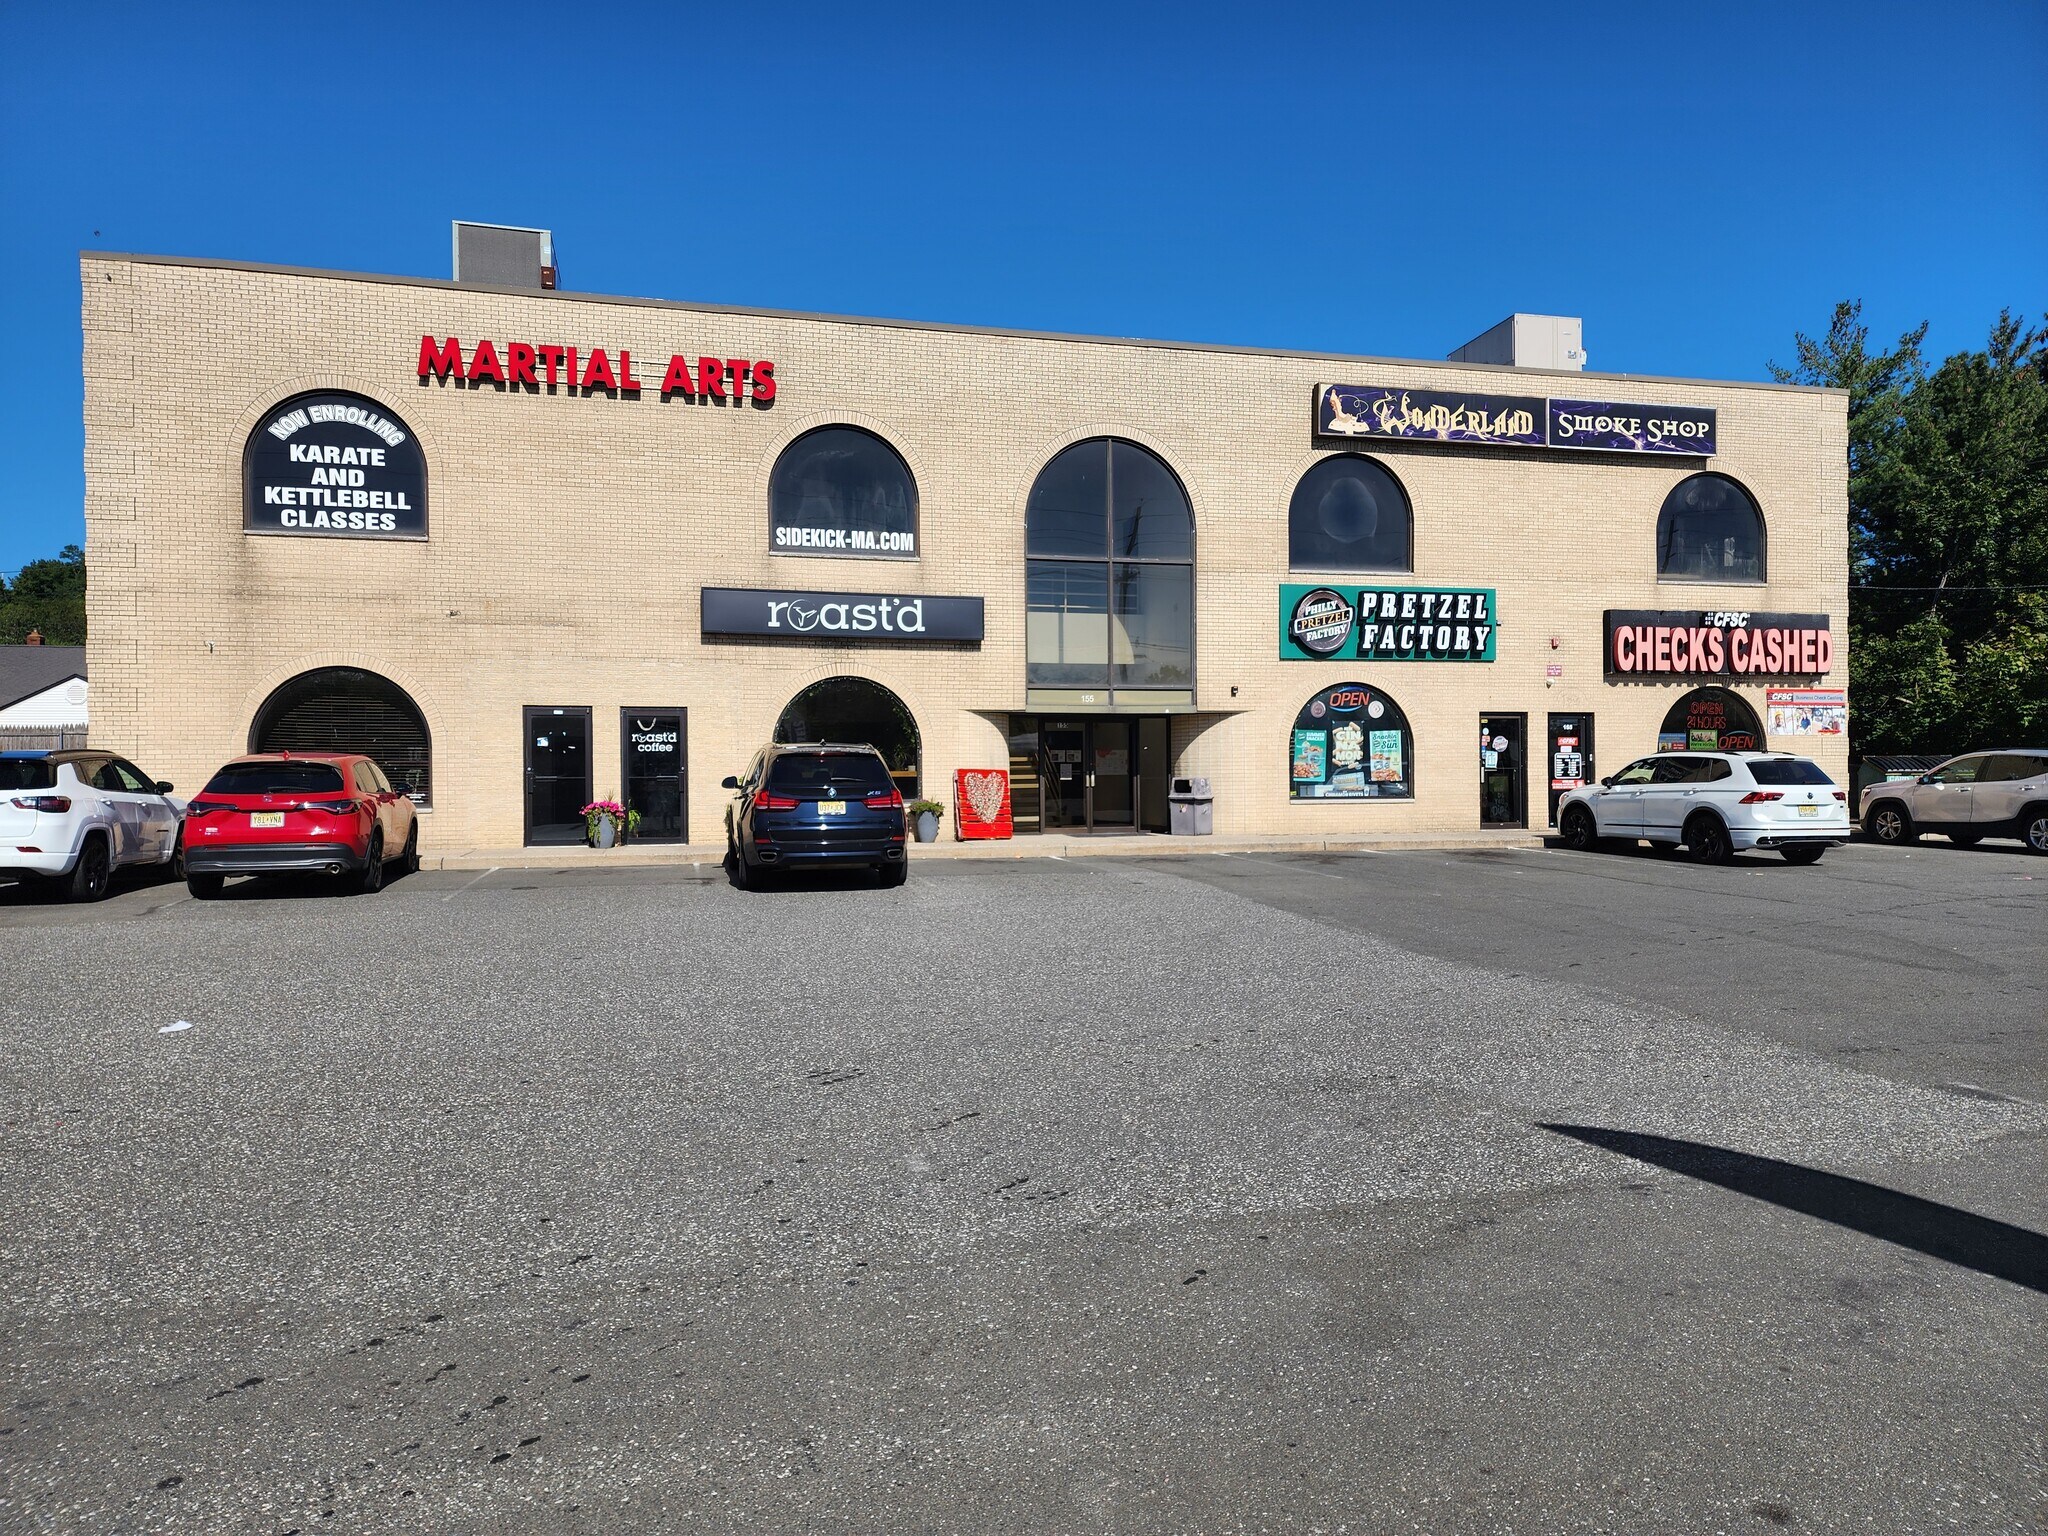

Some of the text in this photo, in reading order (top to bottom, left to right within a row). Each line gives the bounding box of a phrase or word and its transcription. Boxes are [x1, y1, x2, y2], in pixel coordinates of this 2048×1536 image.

[418, 335, 777, 400] MARTIAL ARTS
[268, 404, 406, 447] NOW ENROLLING
[1373, 391, 1533, 440] WONDERLAND
[1558, 414, 1709, 442] SMOKE SHOP
[289, 443, 386, 466] KARATE
[311, 467, 365, 487] AND
[264, 486, 411, 510] KETTLEBELL
[280, 509, 396, 531] CLASSES
[776, 526, 914, 551] SIDEKICK-MA.COM
[1305, 600, 1338, 616] PHILLY
[1363, 592, 1487, 619] PRETZEL
[1301, 611, 1348, 630] PRETZEL
[1713, 611, 1748, 627] CFSC
[1306, 624, 1347, 642] FACTORY
[1363, 624, 1490, 650] FACTORY
[1615, 625, 1833, 674] CHECKS CASHED
[1329, 692, 1370, 707] OPEN
[1771, 692, 1793, 700] CFSC
[1690, 701, 1724, 715] OPEN
[1697, 716, 1727, 729] HOURS
[637, 742, 674, 752] coffee
[1381, 740, 1398, 749] Sun
[1718, 735, 1756, 749] OPEN
